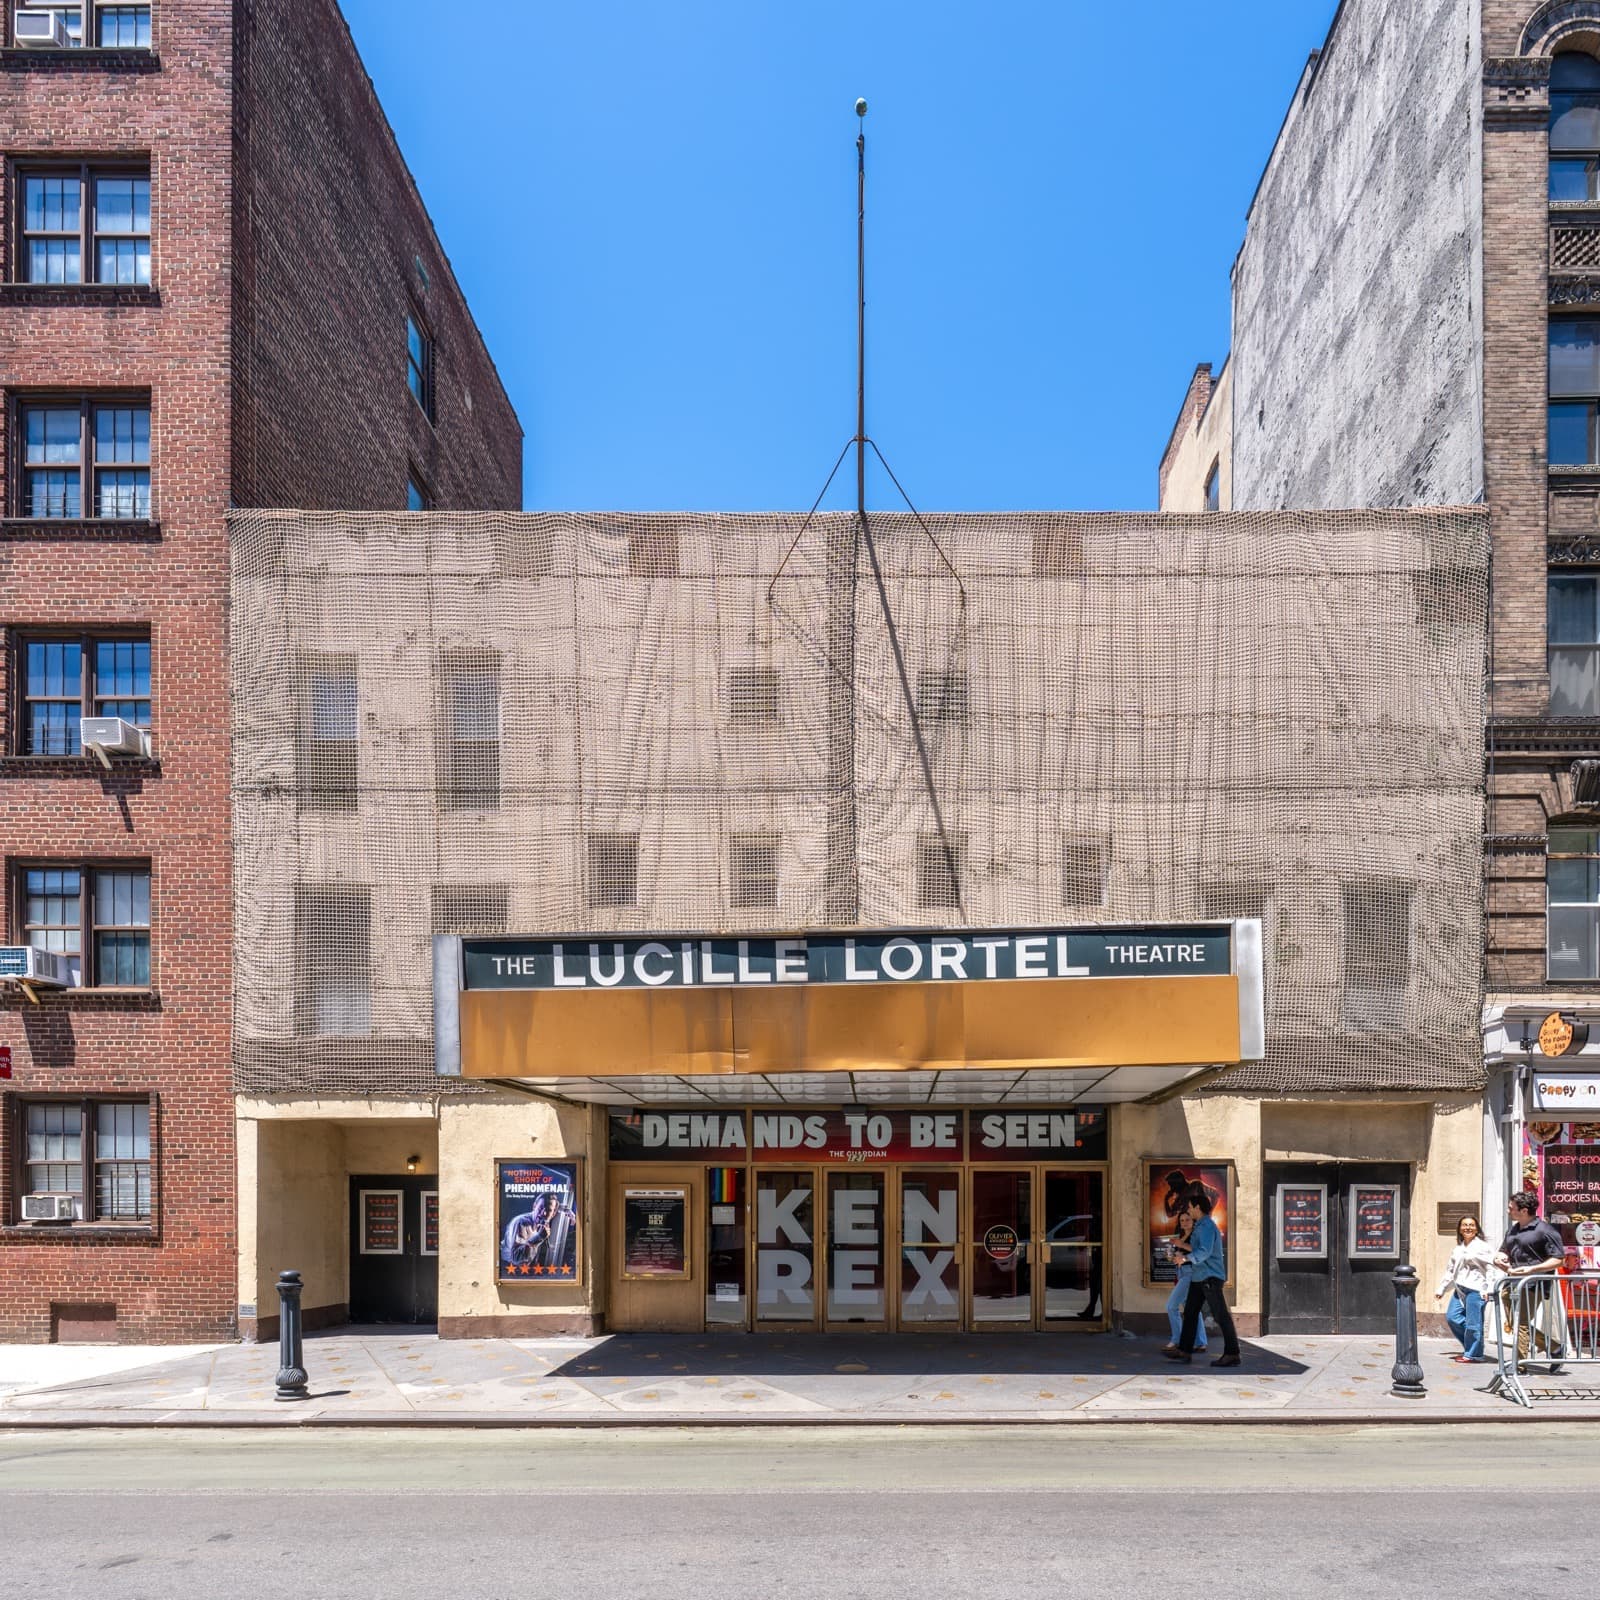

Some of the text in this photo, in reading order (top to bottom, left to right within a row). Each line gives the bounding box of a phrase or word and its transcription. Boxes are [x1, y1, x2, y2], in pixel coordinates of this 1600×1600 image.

[492, 936, 1205, 986] THE LUCILLE LORTEL THEATRE
[845, 1115, 893, 1148] TO
[910, 1115, 956, 1148] BE
[1550, 1194, 1590, 1202] COOKIES
[1555, 1181, 1584, 1190] FRESH
[758, 1189, 957, 1244] KEN
[758, 1250, 957, 1304] REX
